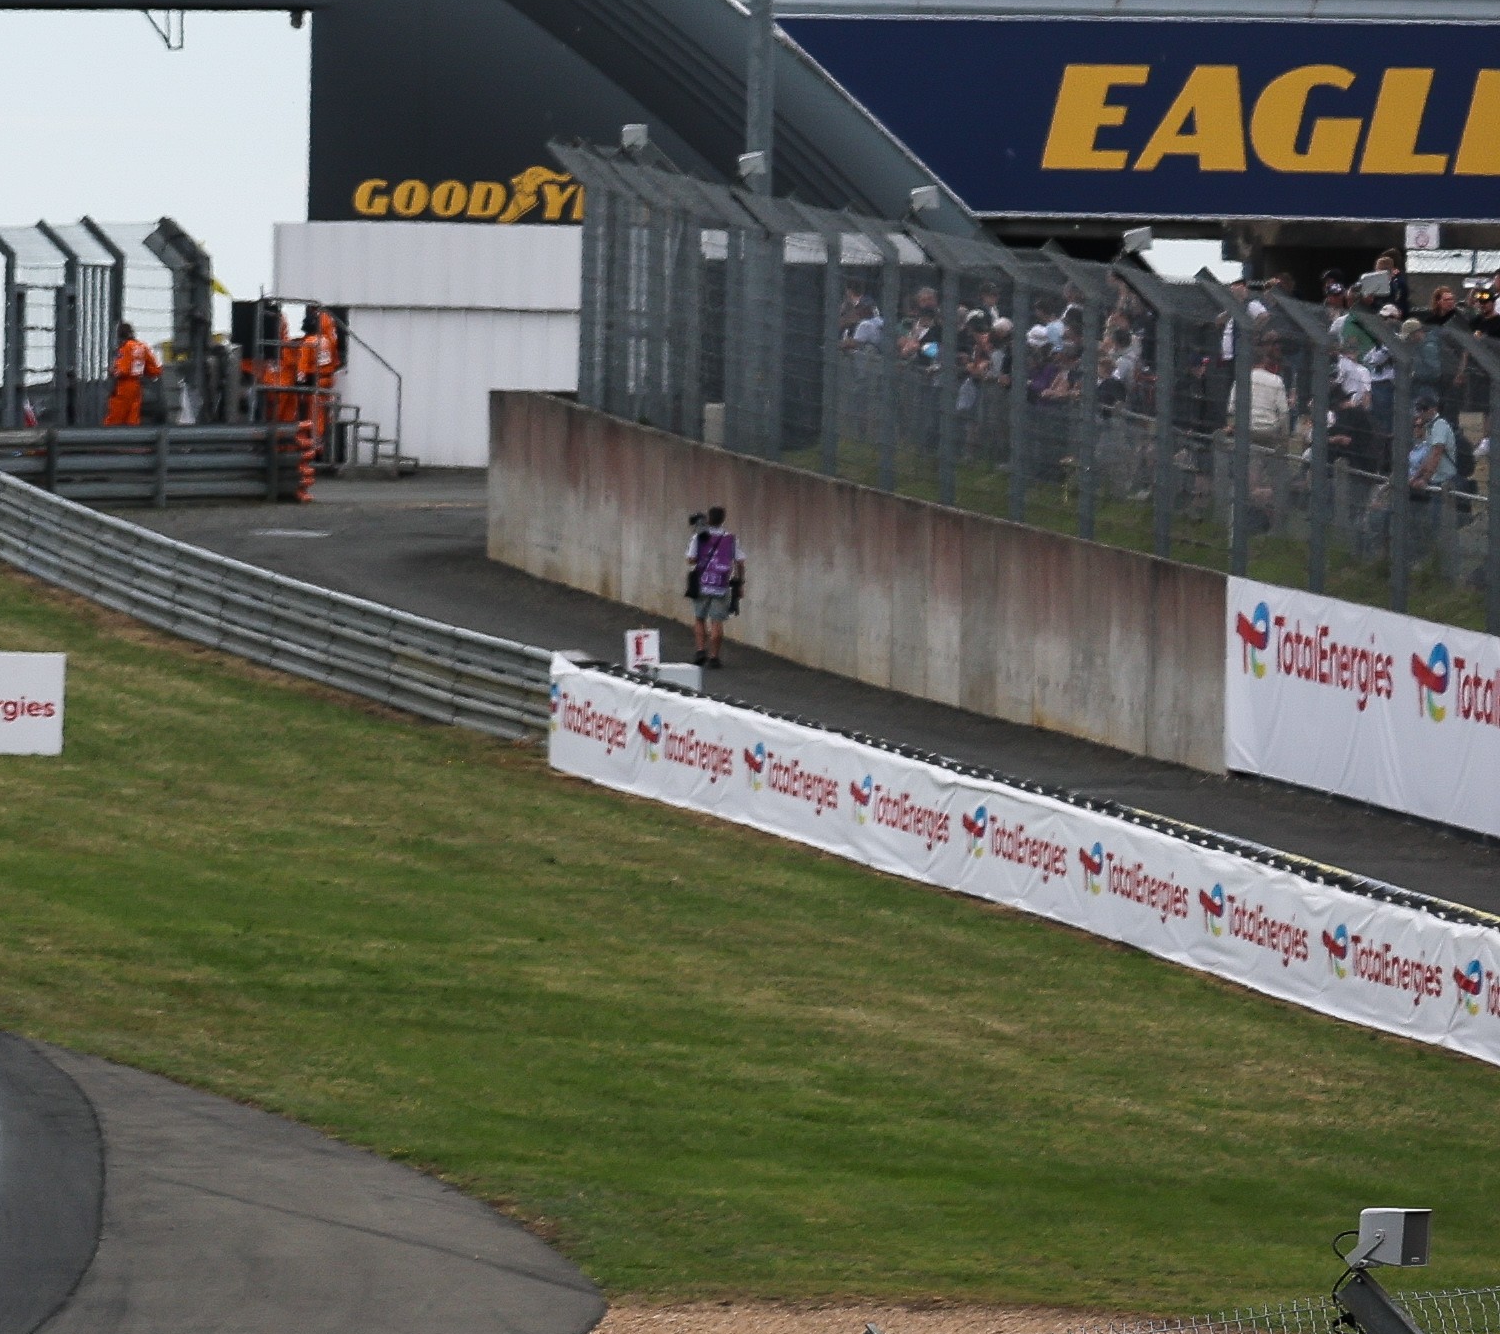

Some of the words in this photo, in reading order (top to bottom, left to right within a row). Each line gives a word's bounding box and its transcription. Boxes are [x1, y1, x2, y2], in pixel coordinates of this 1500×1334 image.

[1273, 615, 1395, 712] TotalEnergies
[767, 750, 838, 812] TotalEnergies
[873, 784, 951, 847] TotalEnergies
[990, 814, 1067, 882] TotalEnergies
[1106, 851, 1189, 921] TotalEnergies
[1226, 893, 1309, 964] TotalEnergies
[1350, 934, 1443, 1006] TotalEnergies
